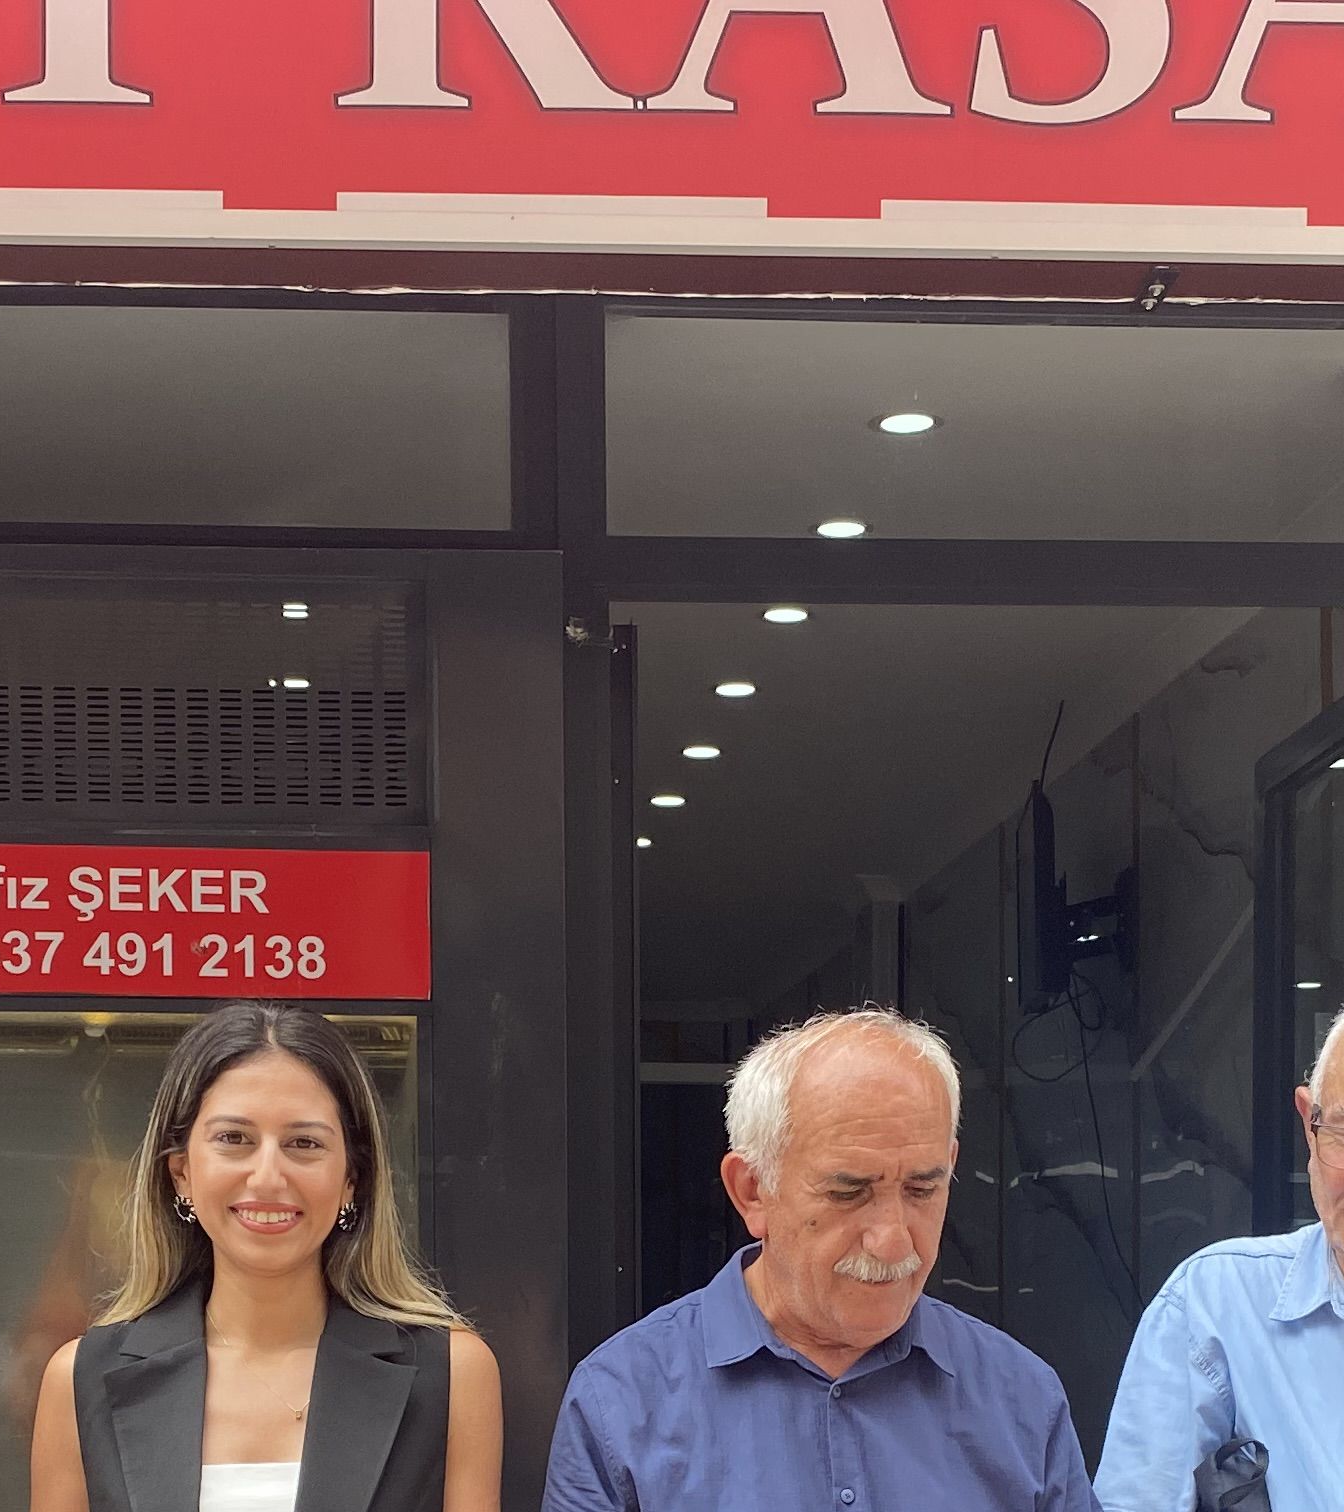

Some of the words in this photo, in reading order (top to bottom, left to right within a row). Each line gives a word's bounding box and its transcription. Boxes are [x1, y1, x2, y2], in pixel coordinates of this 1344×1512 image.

[67, 866, 270, 922] ŞEKER
[82, 932, 175, 977] 491
[198, 934, 328, 980] 2138
